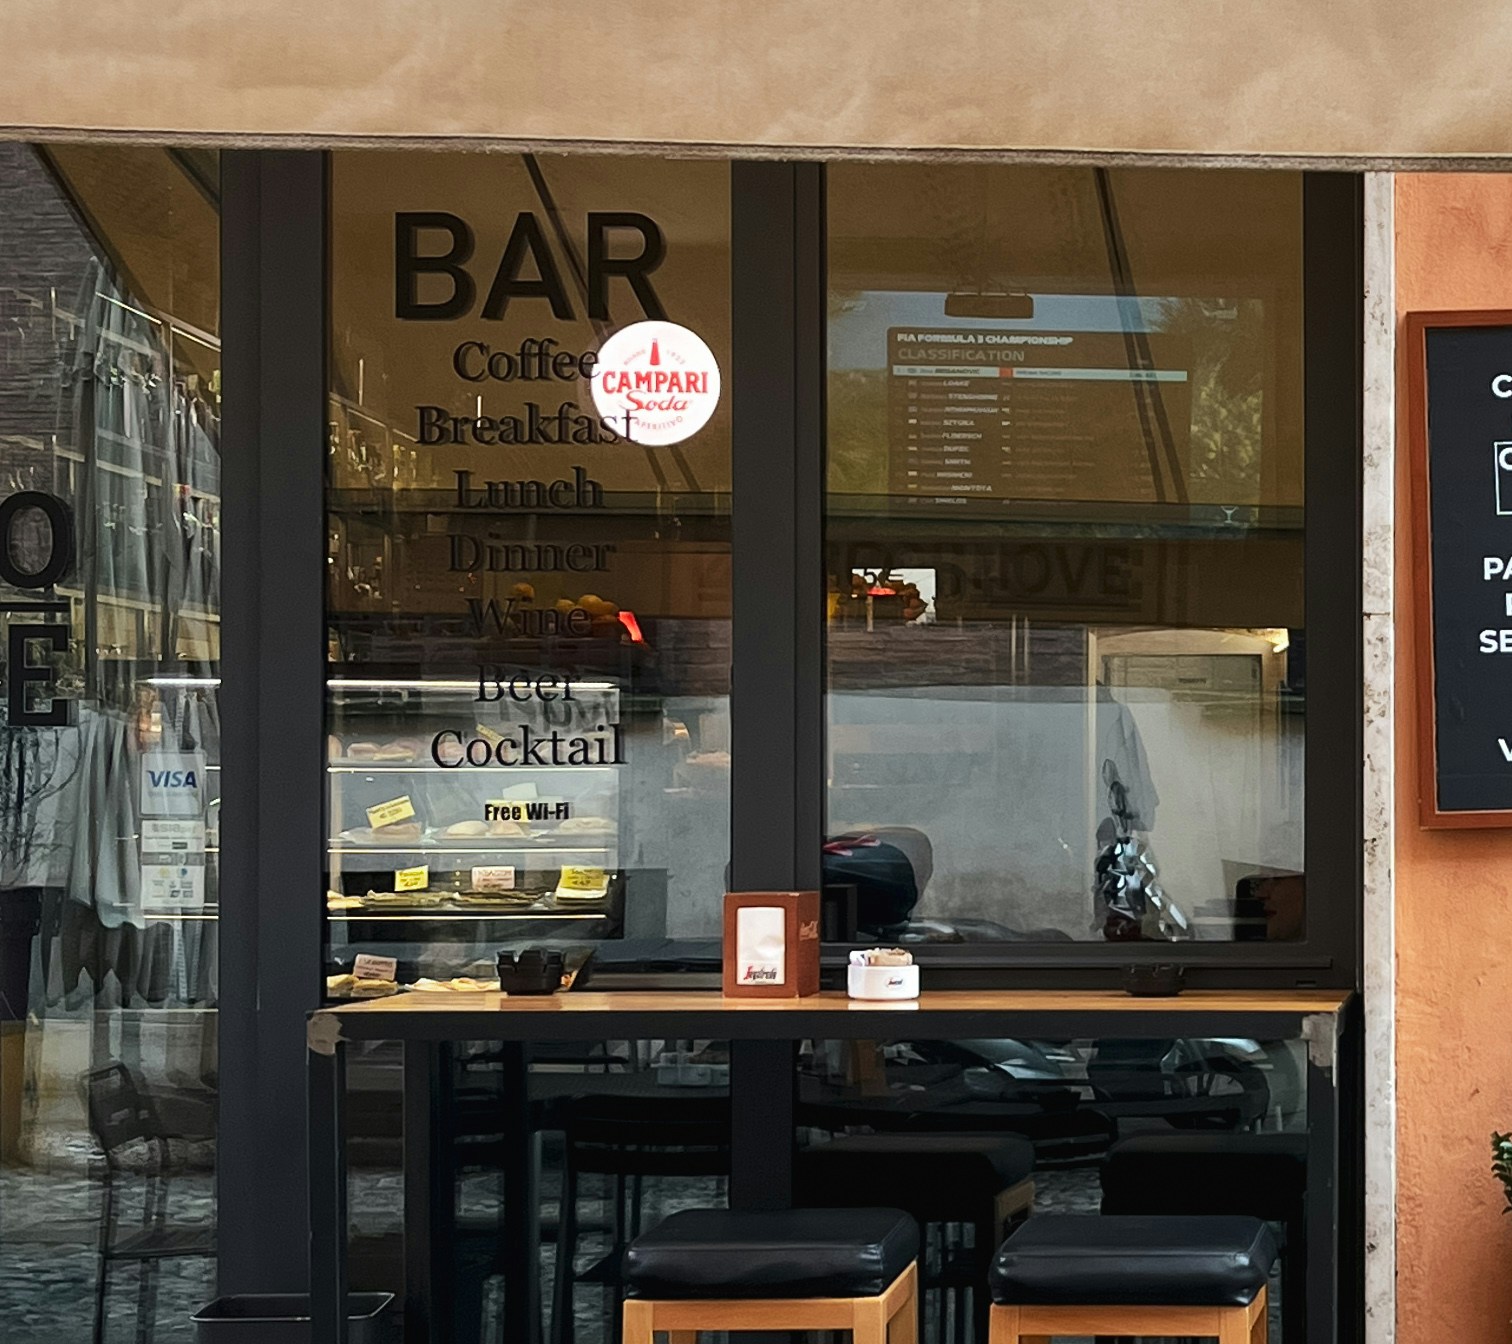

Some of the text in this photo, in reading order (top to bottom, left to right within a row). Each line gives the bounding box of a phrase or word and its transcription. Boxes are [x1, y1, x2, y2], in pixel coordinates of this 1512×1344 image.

[394, 211, 668, 321] BAR
[897, 332, 916, 343] FIA
[897, 347, 1026, 362] CLASSIFICATION
[453, 338, 601, 383] Coffee
[602, 370, 708, 394] CAMPARI
[618, 390, 689, 411] Soda
[416, 401, 638, 445] Breakfast
[454, 466, 605, 510] Lunch
[448, 532, 616, 573] Dinner
[468, 596, 592, 637] Wine
[475, 664, 581, 702] Beer
[431, 724, 628, 768] Cocktail
[147, 770, 197, 788] VISA
[484, 801, 570, 821] Free Wi-Fi
